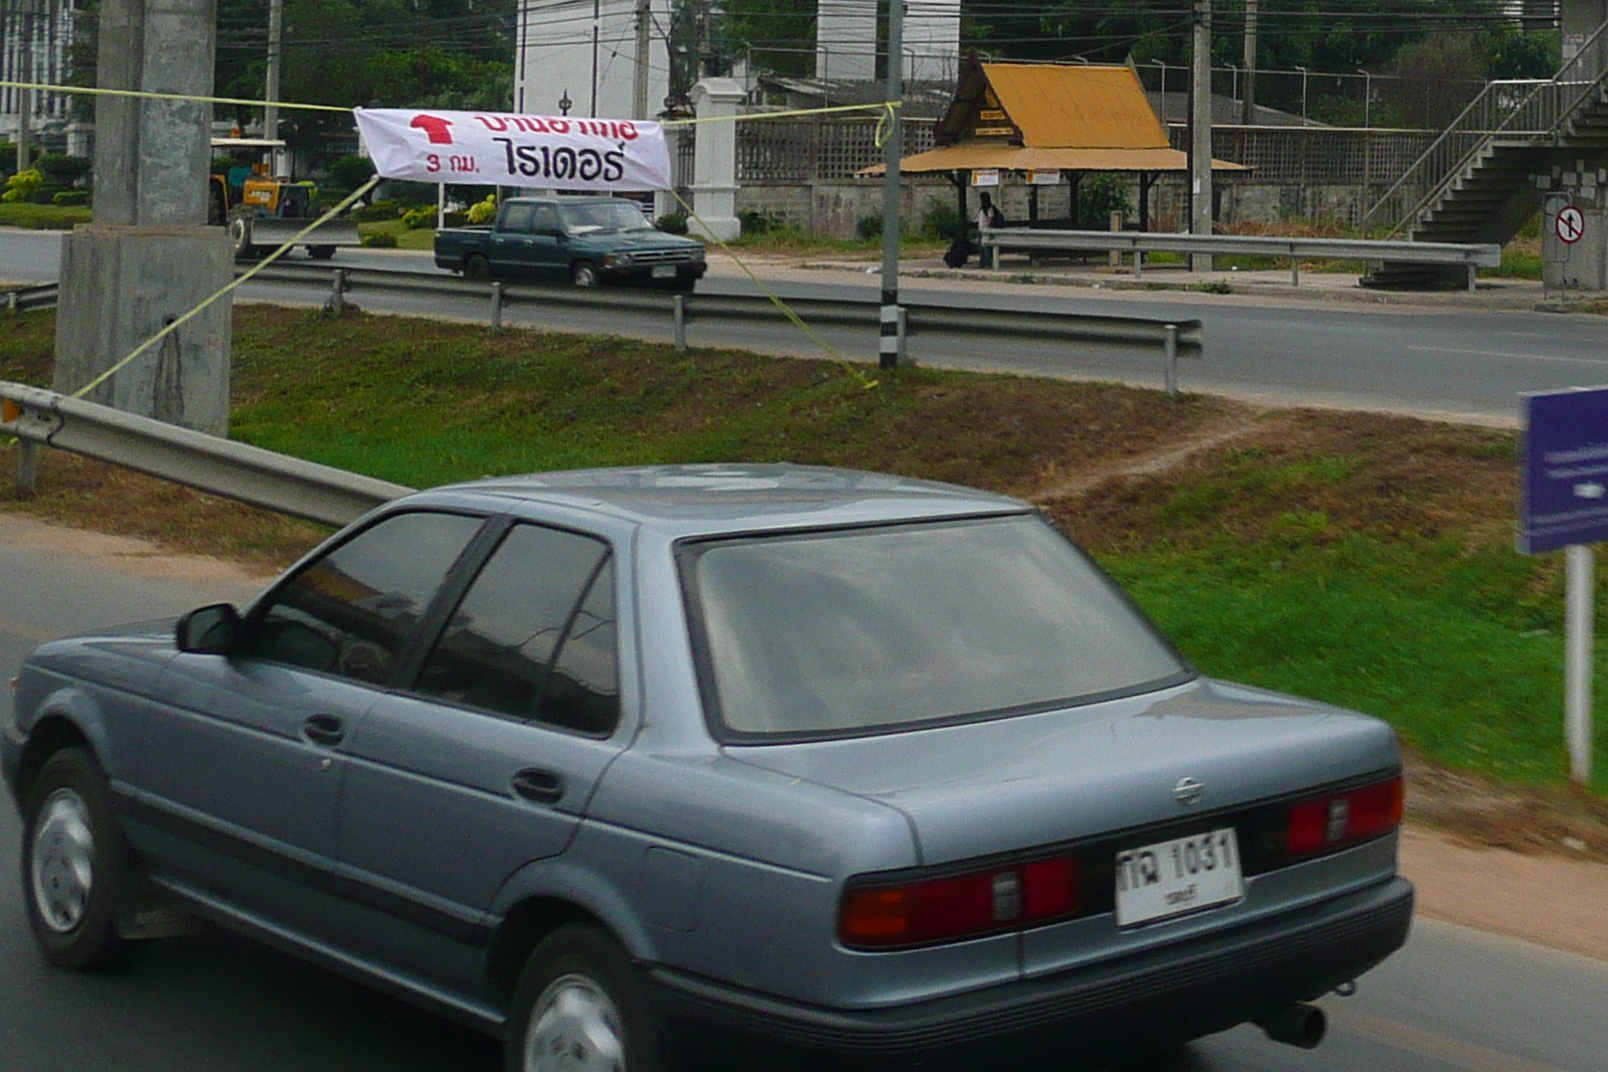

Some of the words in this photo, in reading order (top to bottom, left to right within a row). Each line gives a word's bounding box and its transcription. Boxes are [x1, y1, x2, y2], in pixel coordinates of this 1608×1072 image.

[426, 153, 441, 173] 3
[449, 155, 480, 173] กม.
[493, 137, 627, 182] ไรเดอร์
[1171, 832, 1232, 879] 1031
